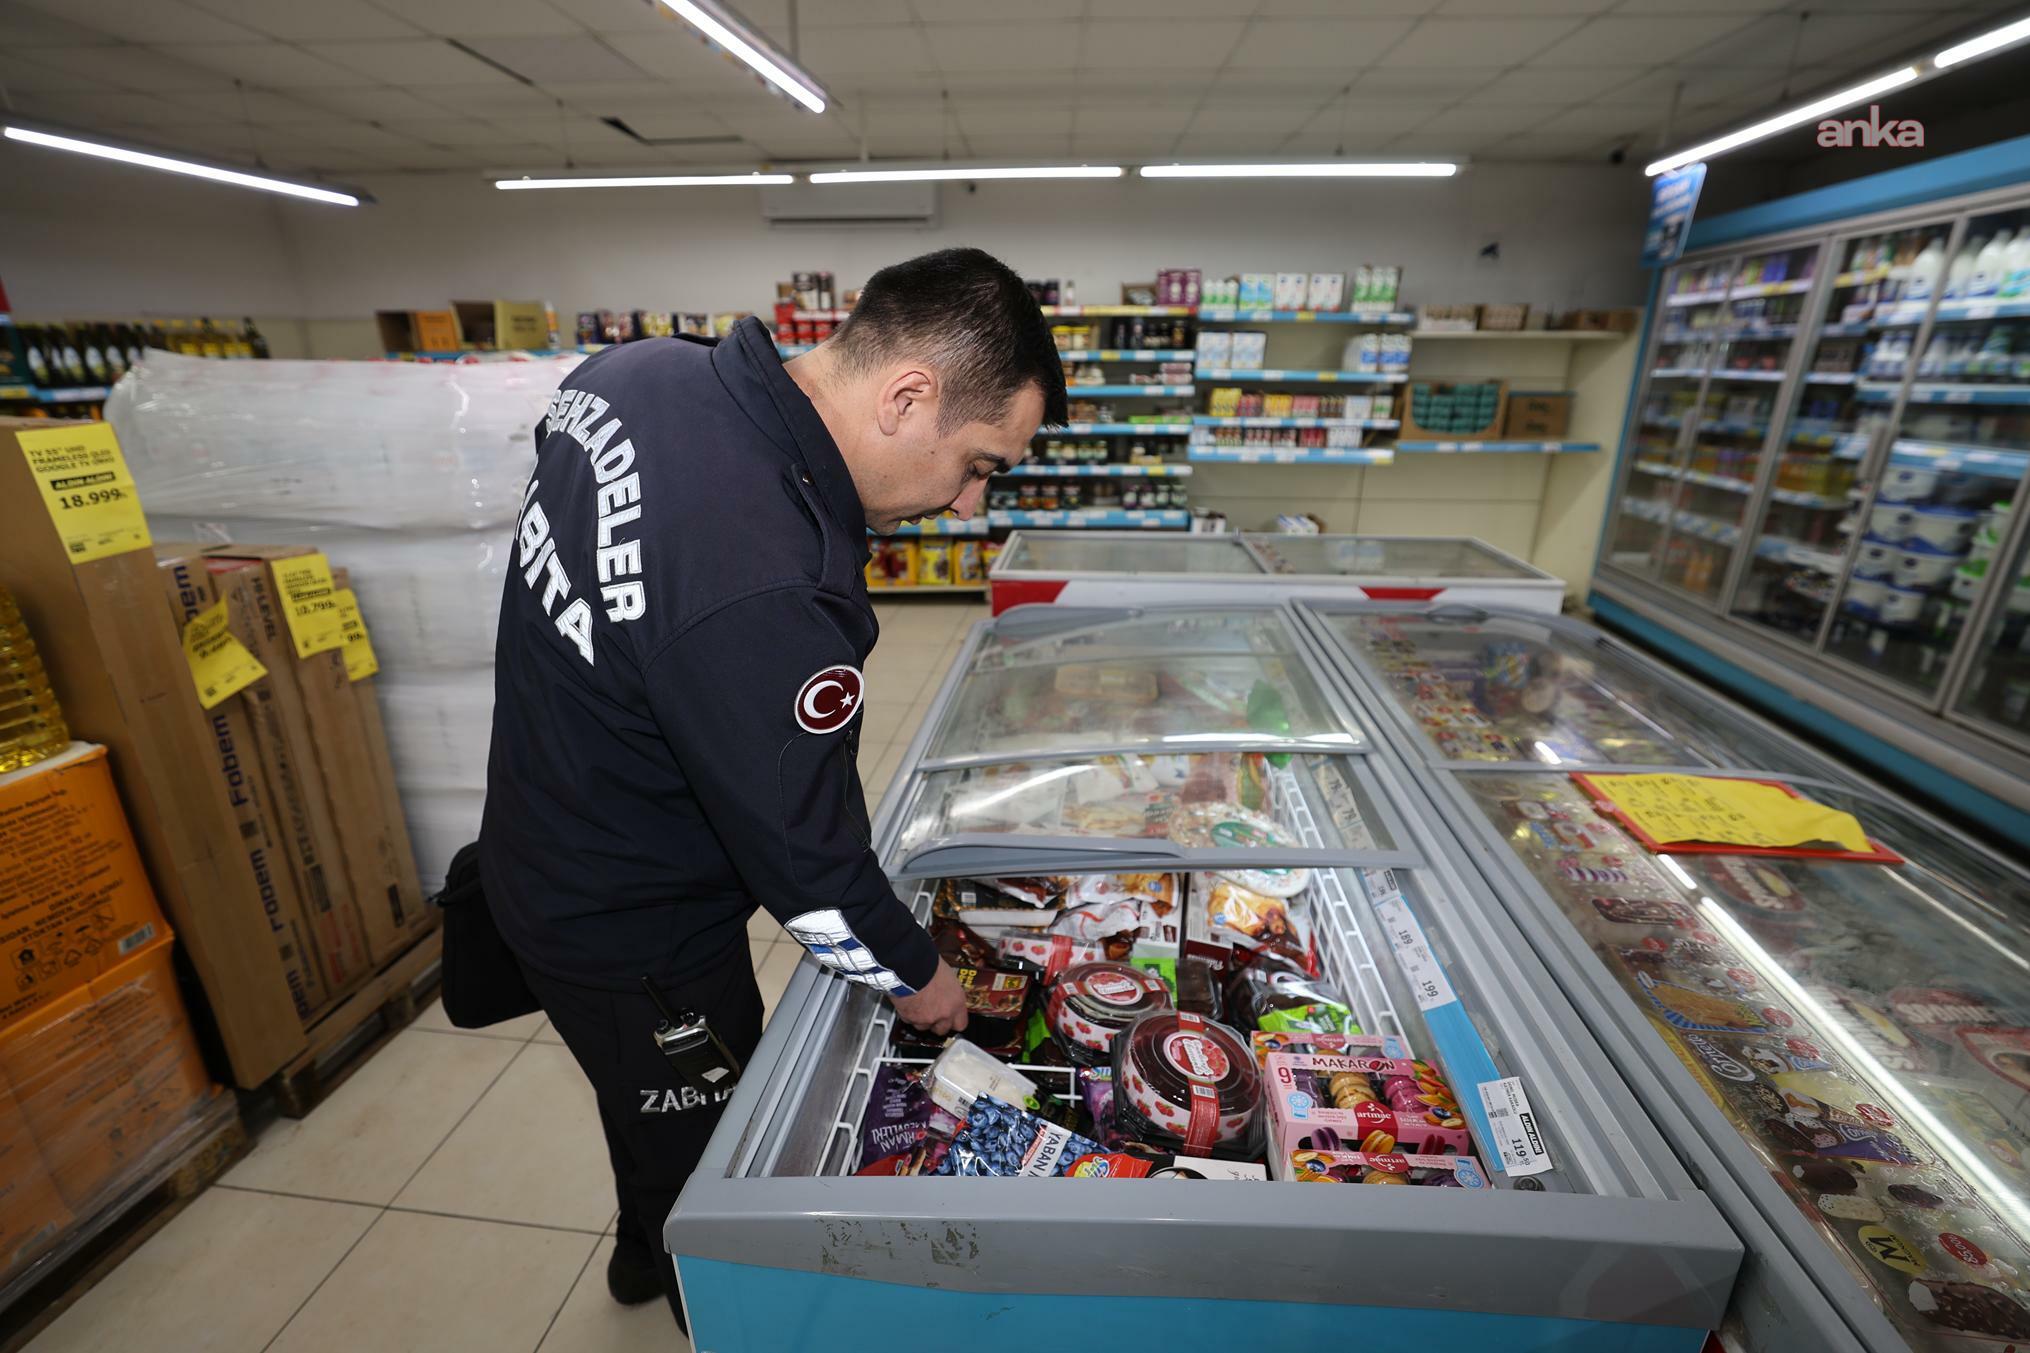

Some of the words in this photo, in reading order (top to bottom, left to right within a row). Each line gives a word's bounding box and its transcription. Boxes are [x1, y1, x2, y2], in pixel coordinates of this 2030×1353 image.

[1422, 980, 1439, 998] 199
[1312, 1057, 1395, 1071] MAKARON
[1278, 1066, 1292, 1084] 9
[1521, 1115, 1534, 1136] ALDIN
[1033, 1130, 1063, 1172] YABAN
